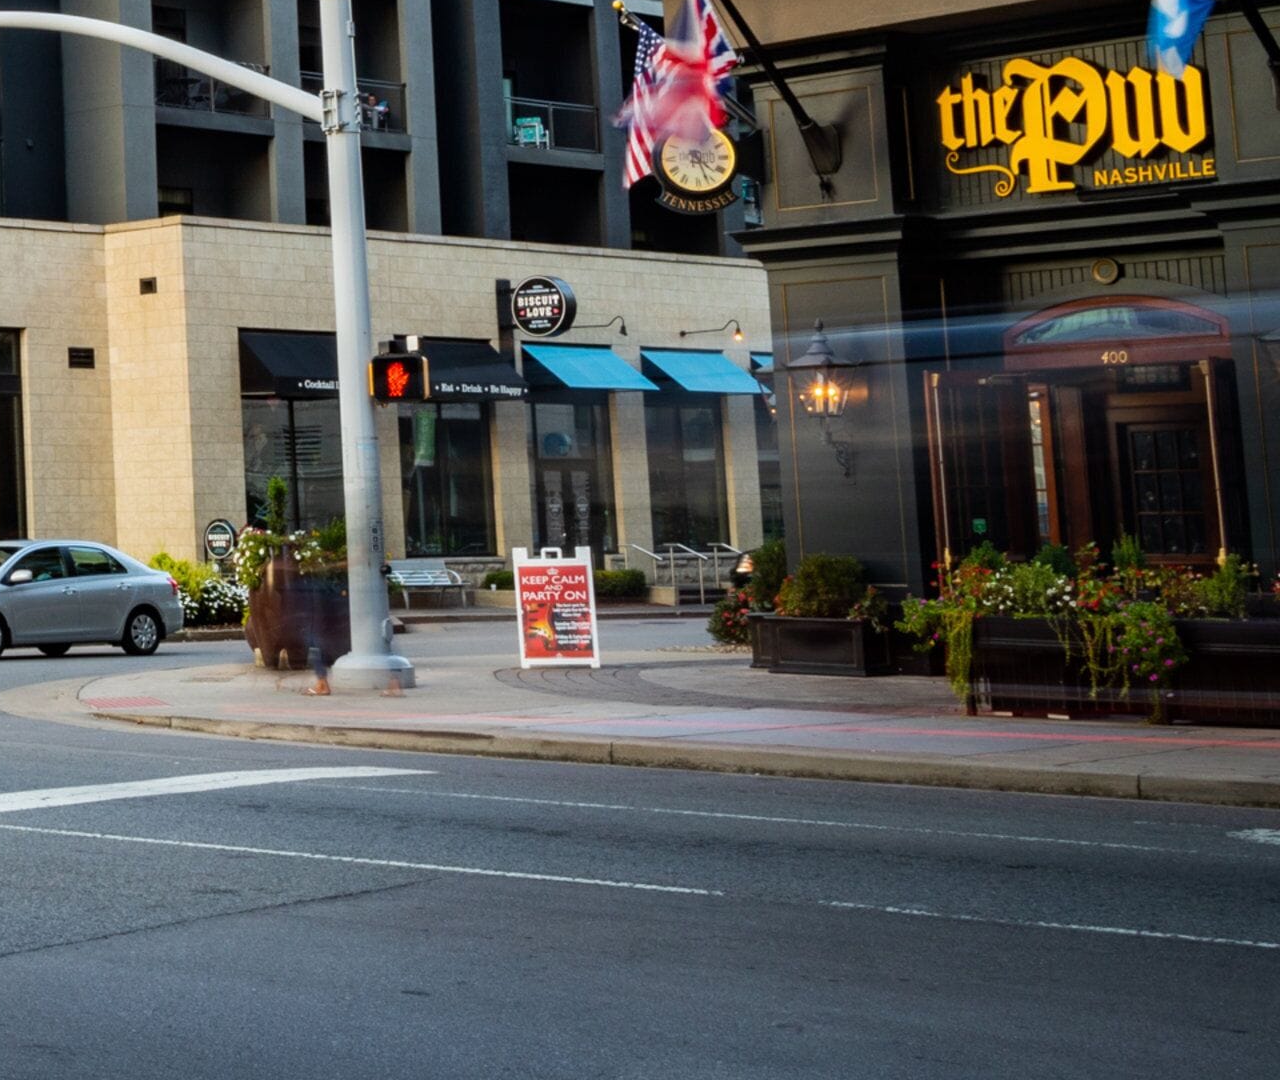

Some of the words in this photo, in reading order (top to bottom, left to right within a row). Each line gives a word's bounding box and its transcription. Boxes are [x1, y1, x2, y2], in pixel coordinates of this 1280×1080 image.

[936, 72, 1023, 151] the
[1093, 159, 1216, 187] NASHVILLE
[663, 190, 736, 212] TENNESSEE
[517, 293, 560, 308] BISCUIT
[526, 306, 553, 318] LOVE
[1101, 350, 1128, 365] 400
[304, 379, 335, 389] Cocktail
[441, 382, 454, 393] Eat
[461, 383, 483, 394] Drink
[489, 384, 499, 394] Be
[500, 384, 522, 397] Happy
[521, 575, 549, 585] KEEP
[551, 574, 585, 584] CALM
[522, 591, 561, 601] PARTY
[564, 590, 587, 600] ON
[544, 584, 564, 592] AND
